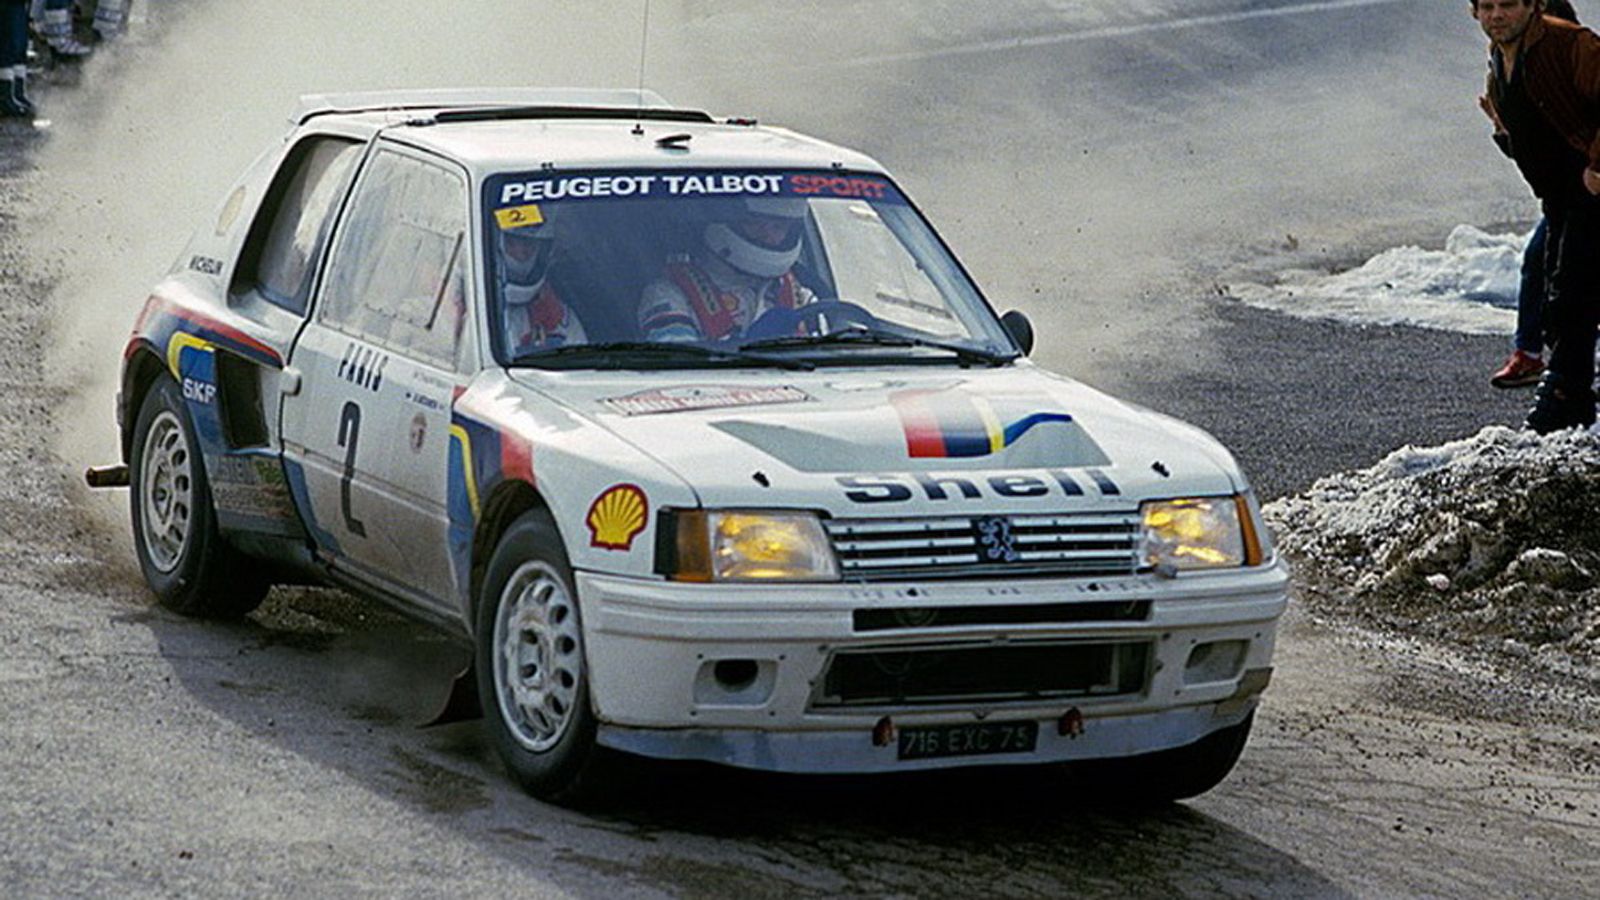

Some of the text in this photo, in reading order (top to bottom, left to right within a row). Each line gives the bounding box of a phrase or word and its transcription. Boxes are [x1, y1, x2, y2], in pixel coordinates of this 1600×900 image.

[501, 175, 887, 203] PEUGEOT TALBOT SPORT
[508, 209, 527, 222] 2
[340, 400, 368, 539] 2
[835, 468, 1121, 503] Shell
[903, 726, 1028, 754] 716 EXC 75
